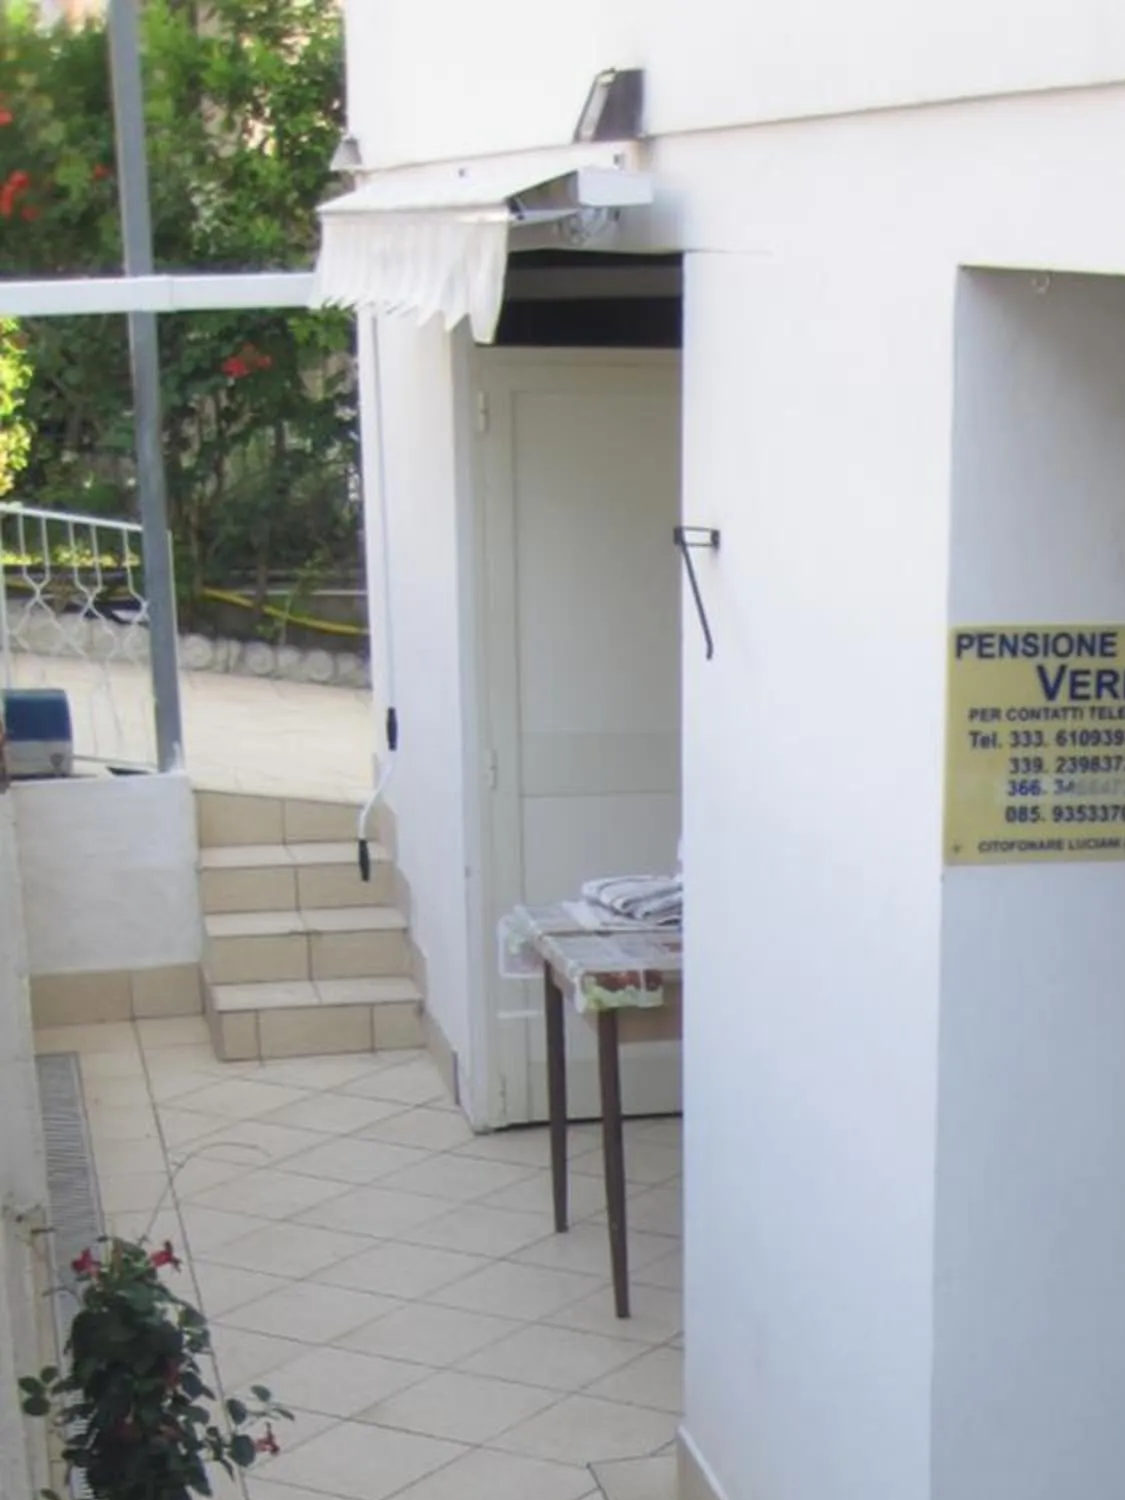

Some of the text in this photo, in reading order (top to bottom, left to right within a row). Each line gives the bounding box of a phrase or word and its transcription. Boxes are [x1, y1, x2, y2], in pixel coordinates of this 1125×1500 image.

[956, 631, 1118, 659] PENSIONE
[968, 707, 1002, 722] PER
[1006, 706, 1083, 721] CONTATTI
[968, 730, 1003, 749] Tel.
